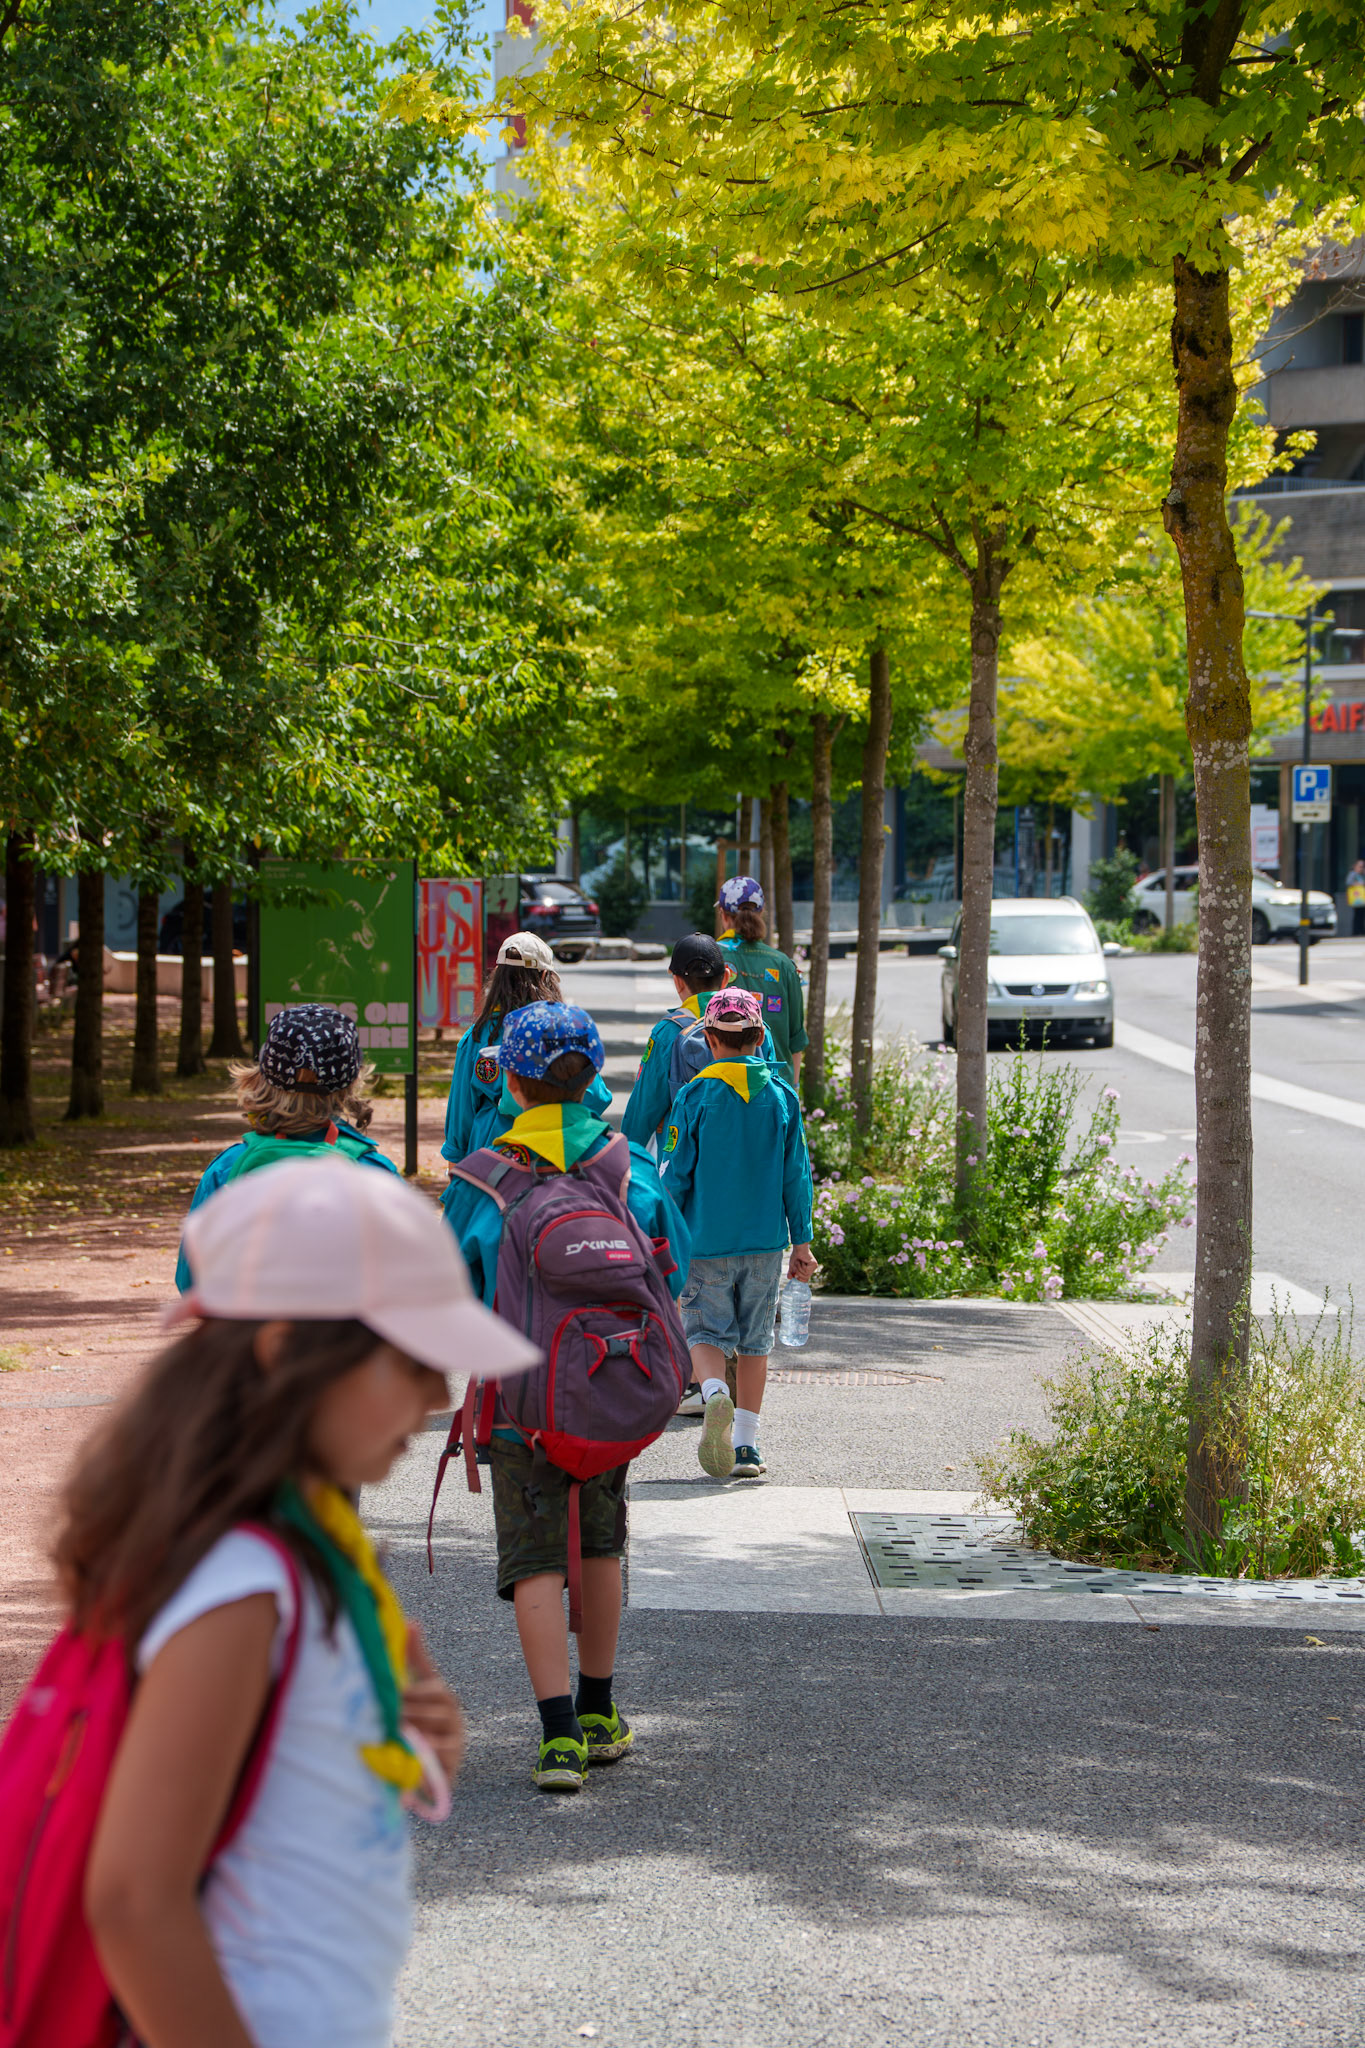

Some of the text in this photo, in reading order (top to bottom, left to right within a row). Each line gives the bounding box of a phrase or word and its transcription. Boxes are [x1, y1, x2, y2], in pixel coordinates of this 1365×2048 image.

[1300, 771, 1317, 797] P
[364, 1002, 409, 1025] ON
[357, 1026, 409, 1049] IRE
[565, 1240, 630, 1255] DAKINE
